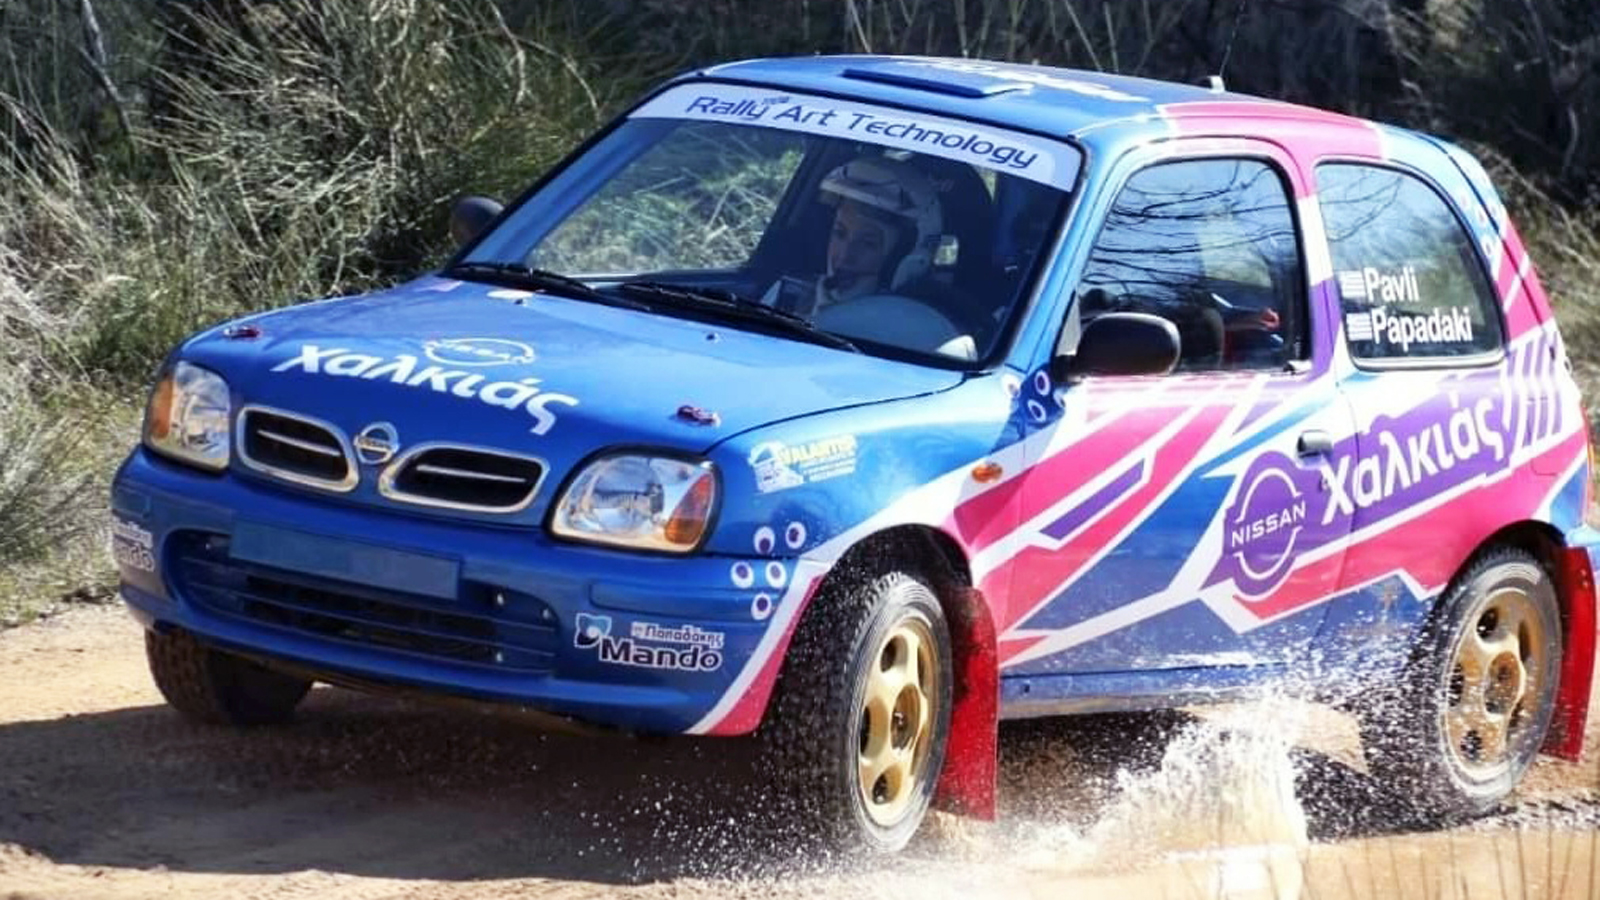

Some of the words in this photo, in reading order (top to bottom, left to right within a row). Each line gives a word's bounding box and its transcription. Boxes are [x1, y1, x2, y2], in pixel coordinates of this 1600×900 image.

[686, 95, 769, 121] Rally
[773, 105, 837, 128] Art
[852, 113, 1038, 171] Technology
[1363, 266, 1420, 303] Pavli
[1371, 306, 1473, 352] Papadaki
[1231, 500, 1306, 548] NISSAN
[600, 637, 722, 671] Mando
